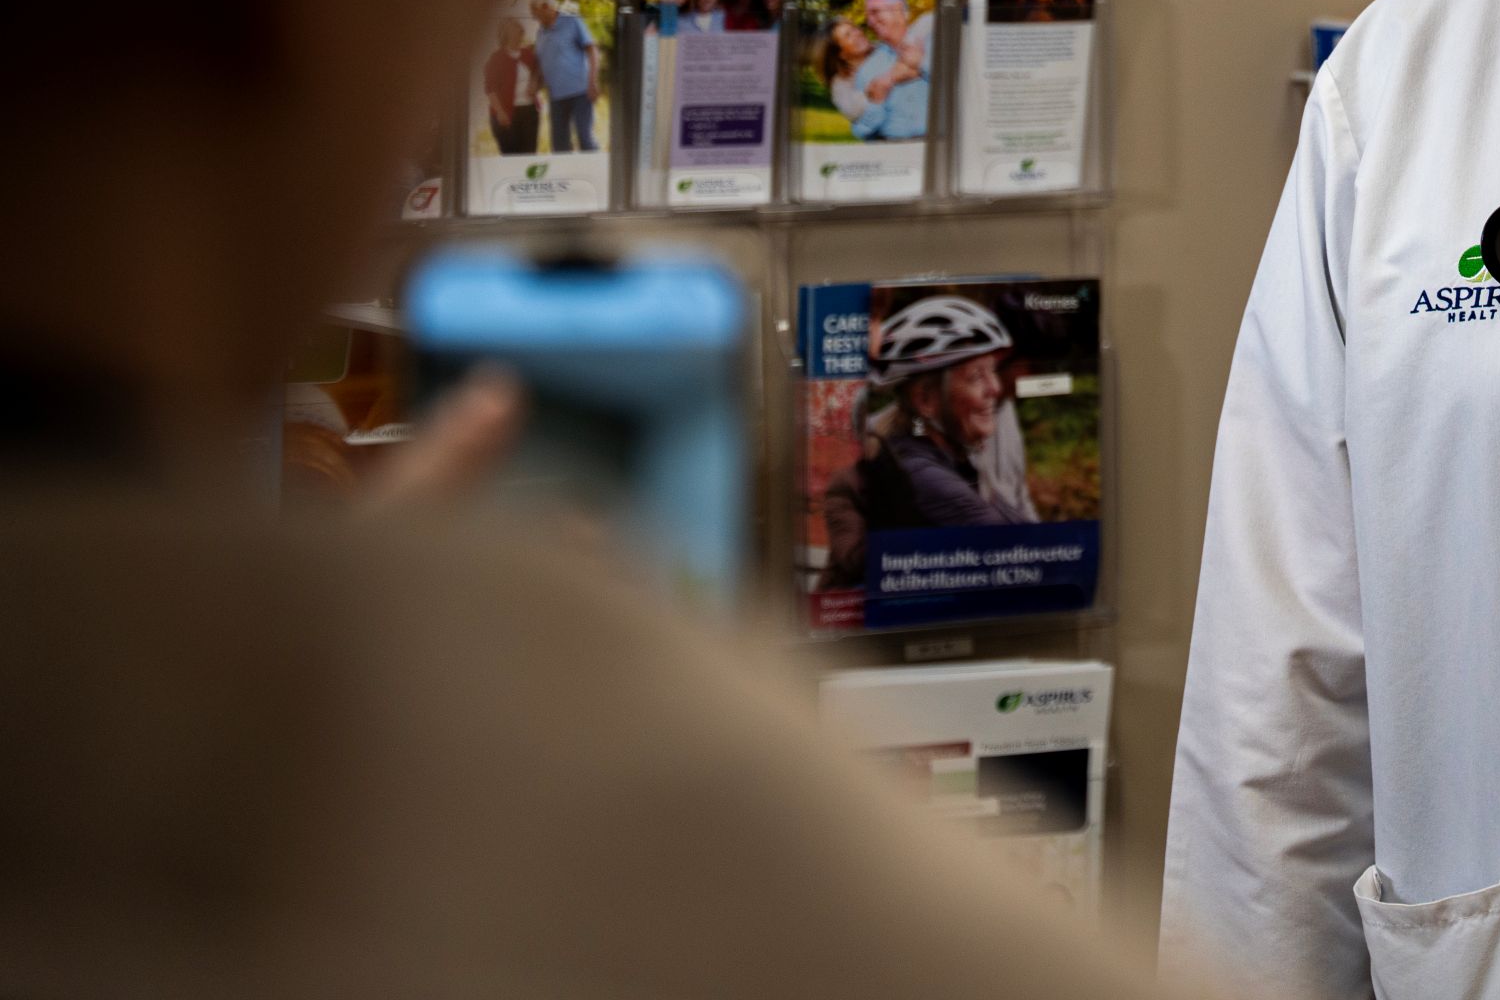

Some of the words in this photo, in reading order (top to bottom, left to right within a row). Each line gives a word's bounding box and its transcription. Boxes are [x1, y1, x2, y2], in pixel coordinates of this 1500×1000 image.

[1025, 293, 1079, 310] Krames
[822, 354, 867, 374] THER
[881, 548, 981, 572] Implantable
[983, 545, 1084, 567] cardioverter
[880, 569, 989, 593] defibrillators
[1025, 689, 1093, 707] ASPIRUS
